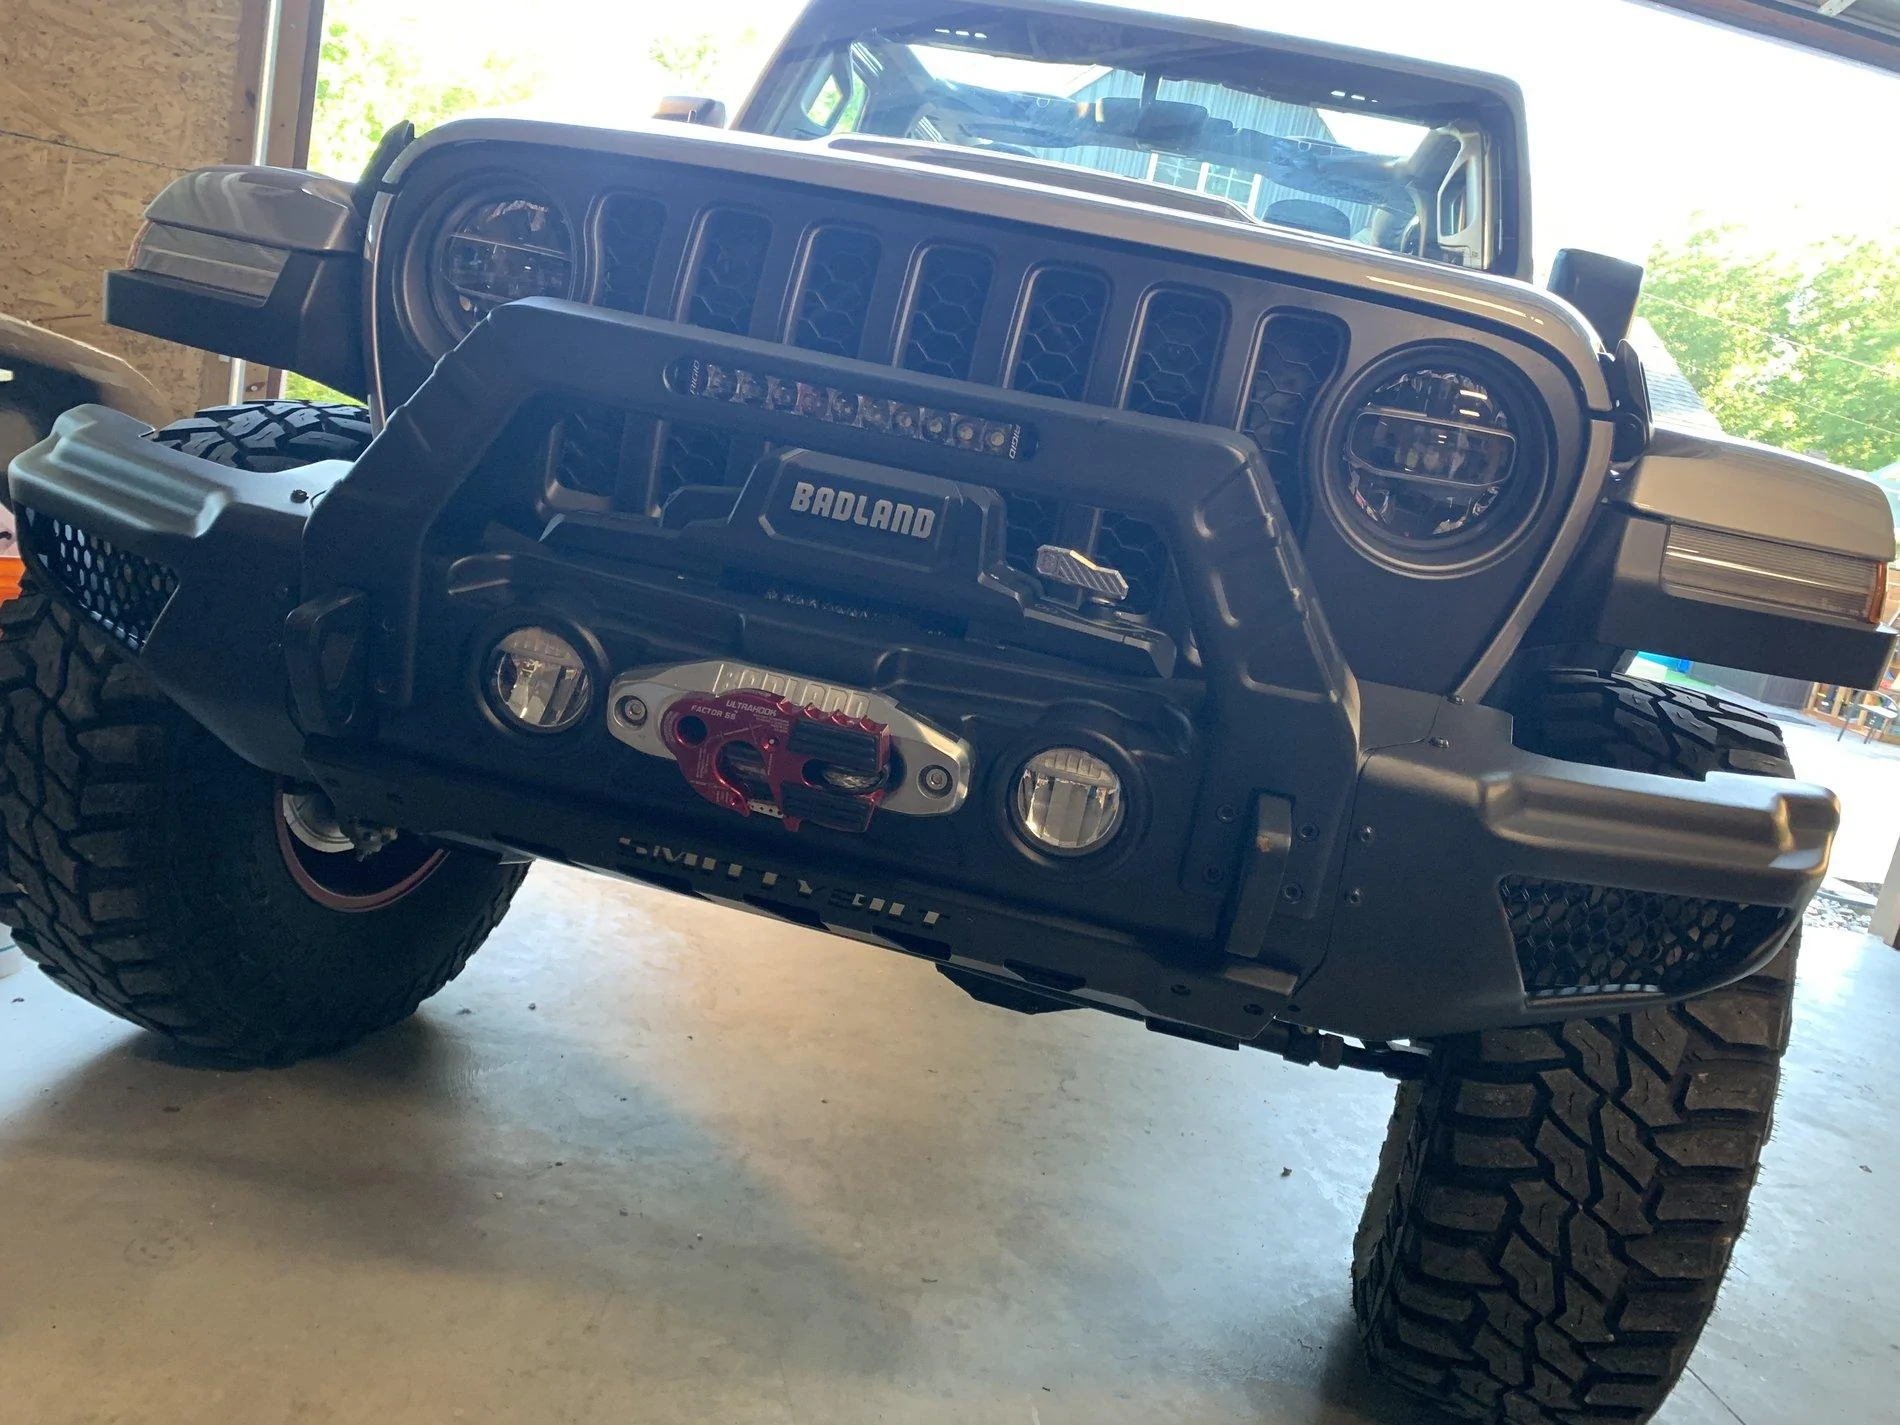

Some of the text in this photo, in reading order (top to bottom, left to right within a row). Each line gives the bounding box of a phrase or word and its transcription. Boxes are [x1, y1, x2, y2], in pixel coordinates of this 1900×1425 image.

[790, 481, 936, 539] BADLAND
[690, 704, 723, 717] FACTOR
[726, 700, 777, 717] ULTRAHOOK
